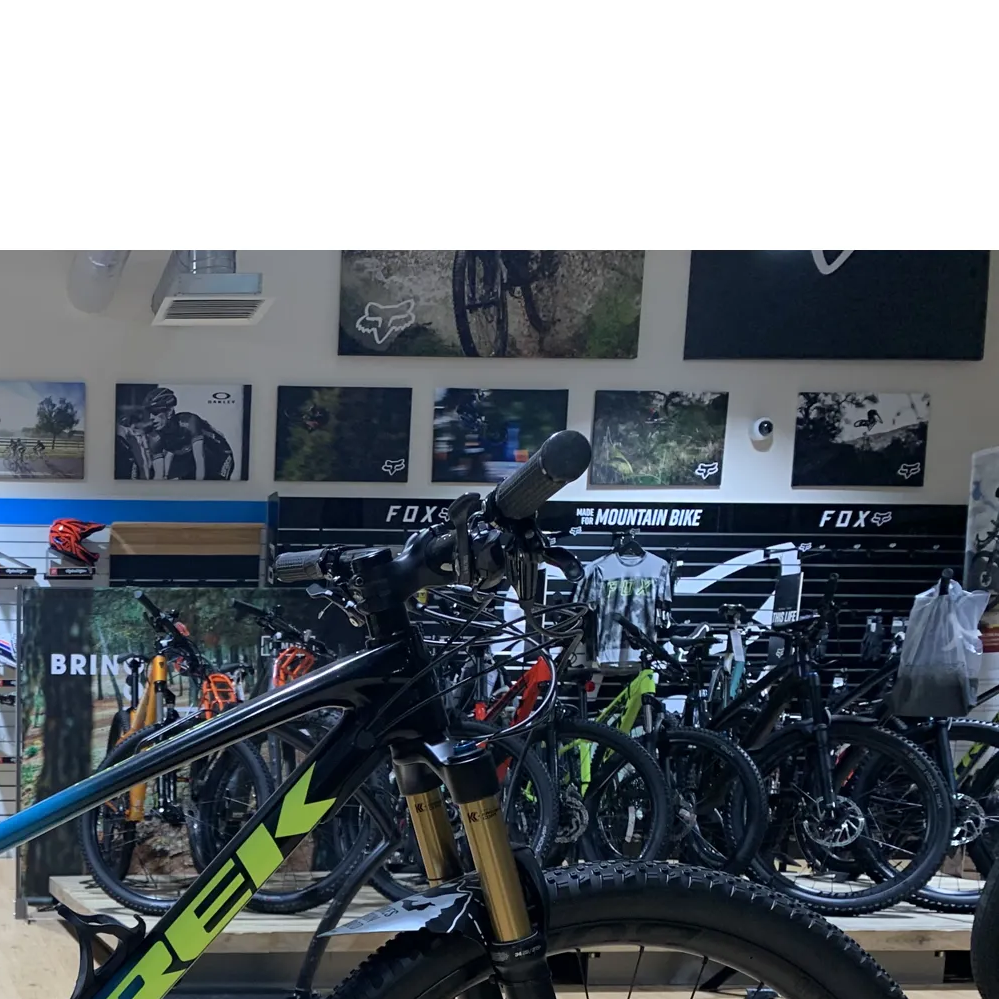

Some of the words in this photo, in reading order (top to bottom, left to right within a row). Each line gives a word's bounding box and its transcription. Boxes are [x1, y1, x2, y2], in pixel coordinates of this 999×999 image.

[386, 505, 434, 523] FOX
[576, 508, 595, 517] MADE
[581, 517, 594, 526] FOR
[595, 508, 668, 526] MOUNTAIN
[668, 509, 703, 527] BIKE
[819, 510, 870, 528] FOX
[607, 580, 652, 598] FOX
[773, 611, 785, 623] THIS
[784, 610, 798, 622] LIFE
